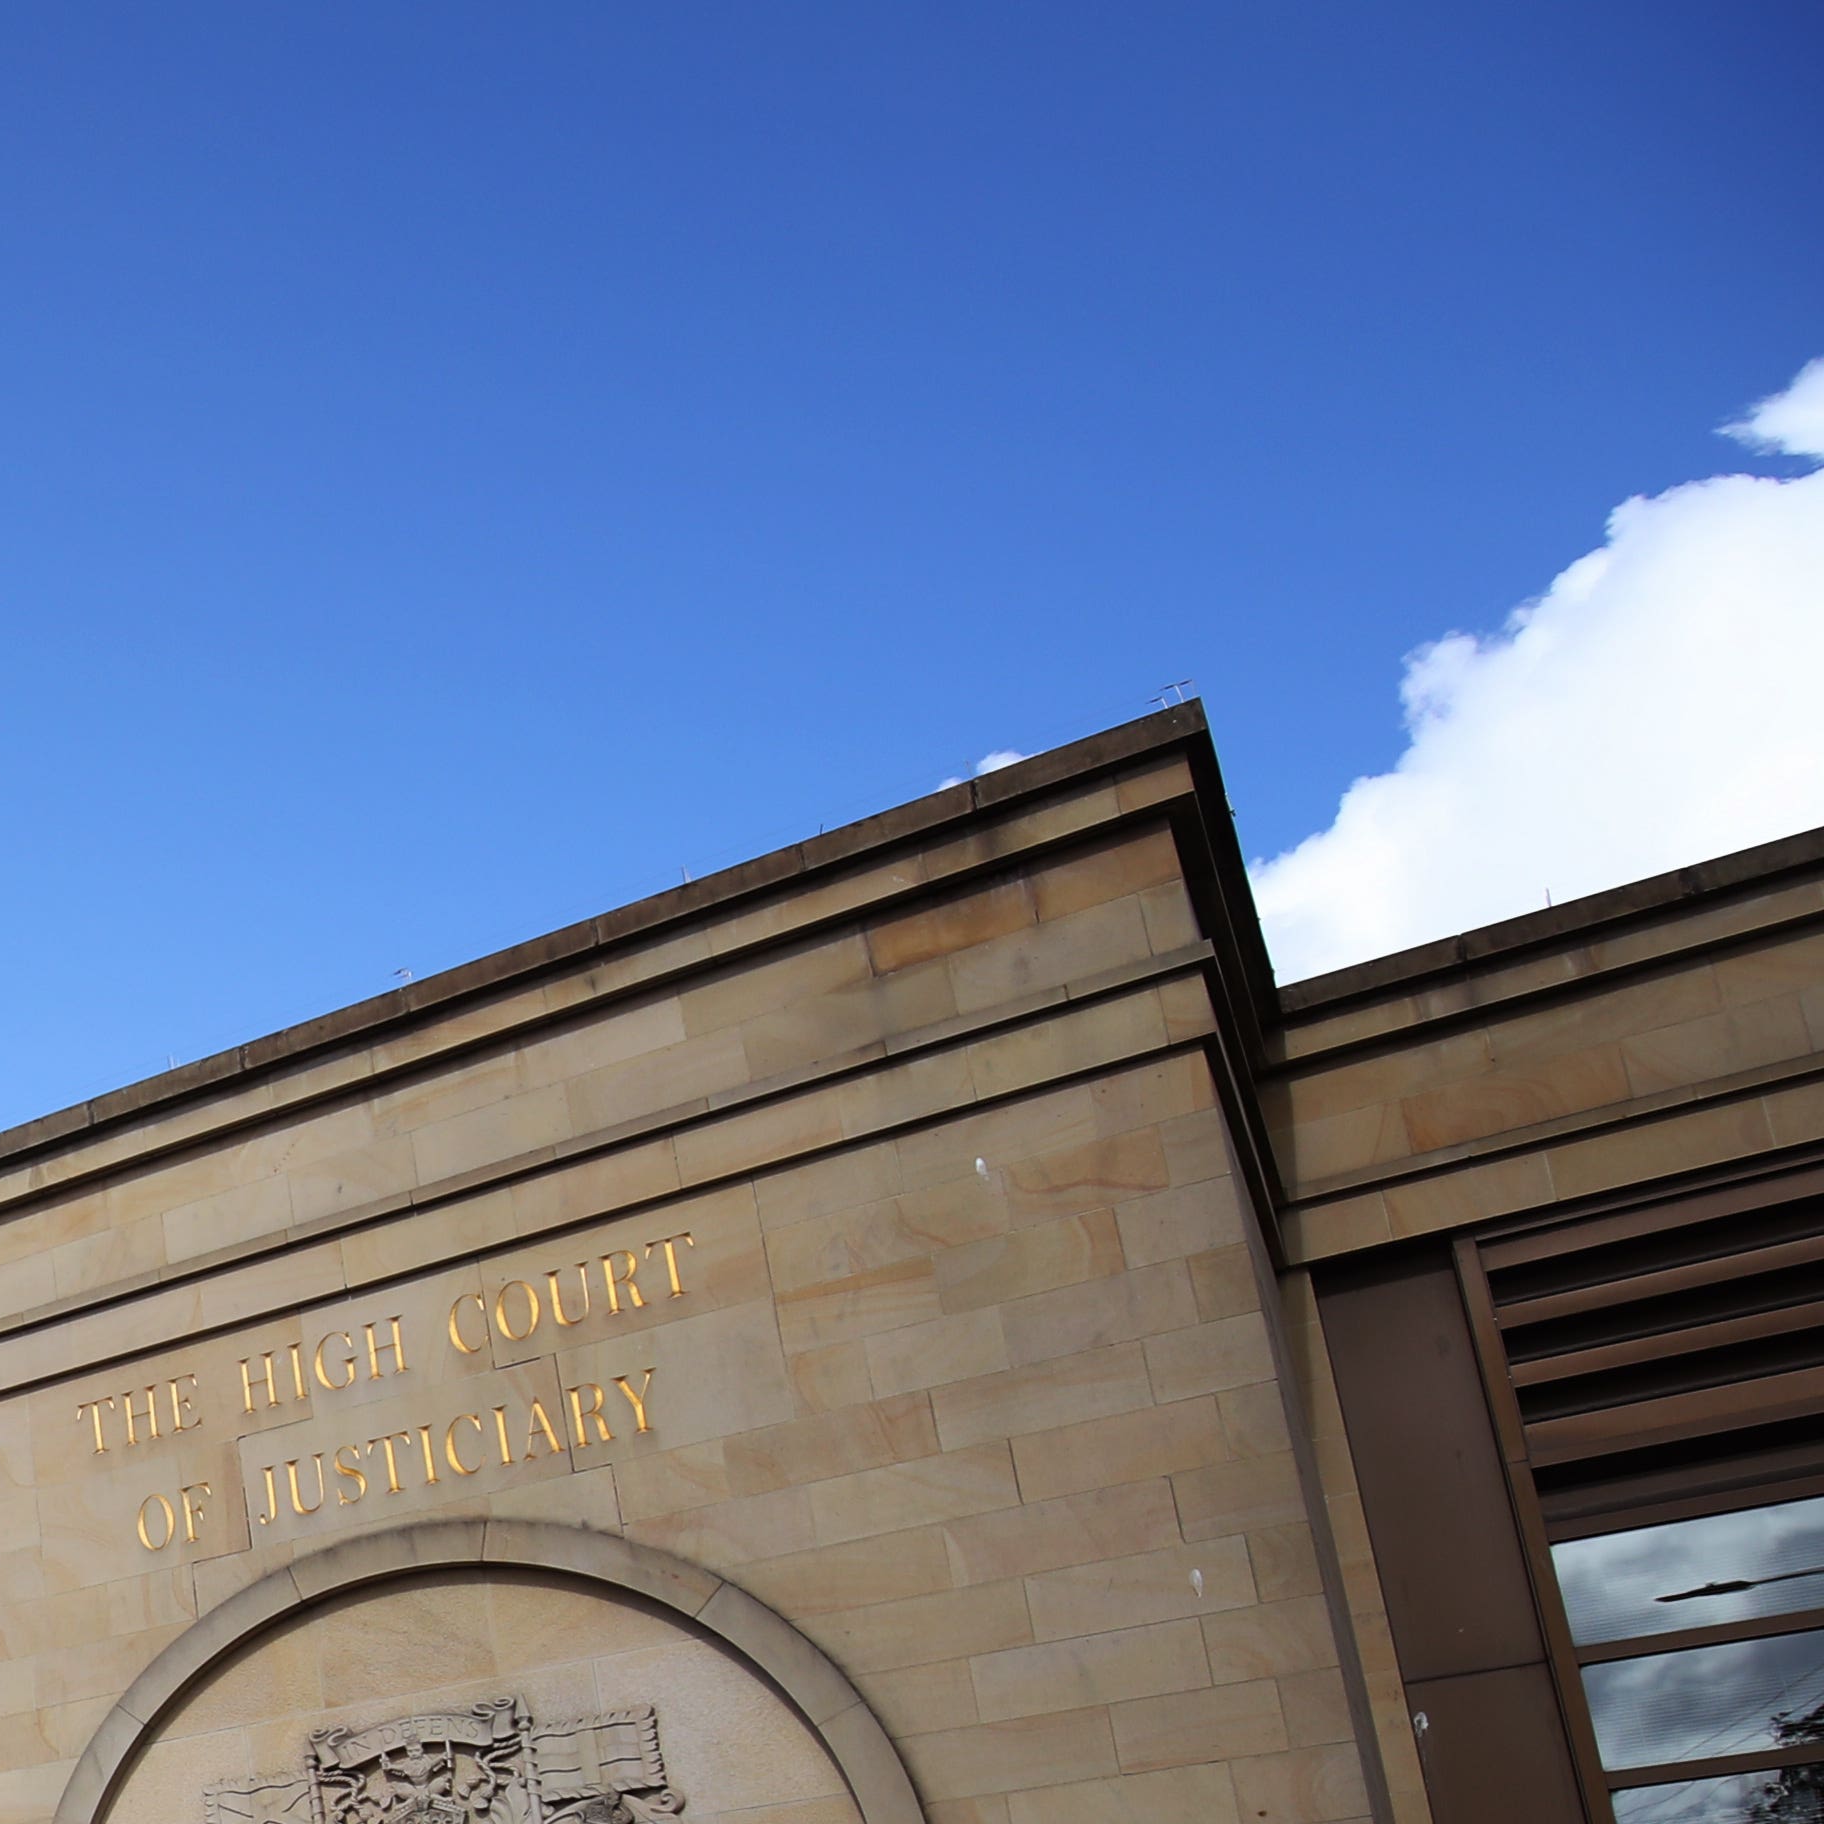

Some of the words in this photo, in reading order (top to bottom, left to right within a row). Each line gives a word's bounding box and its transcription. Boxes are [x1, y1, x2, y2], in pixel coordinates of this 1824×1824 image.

[77, 1373, 203, 1455] THE
[238, 1313, 410, 1415] HIGH
[448, 1231, 696, 1354] COURT
[136, 1482, 212, 1551] OF
[259, 1367, 656, 1526] JUSTICIARY
[342, 1734, 371, 1760] IN
[377, 1716, 479, 1745] DEFENS
